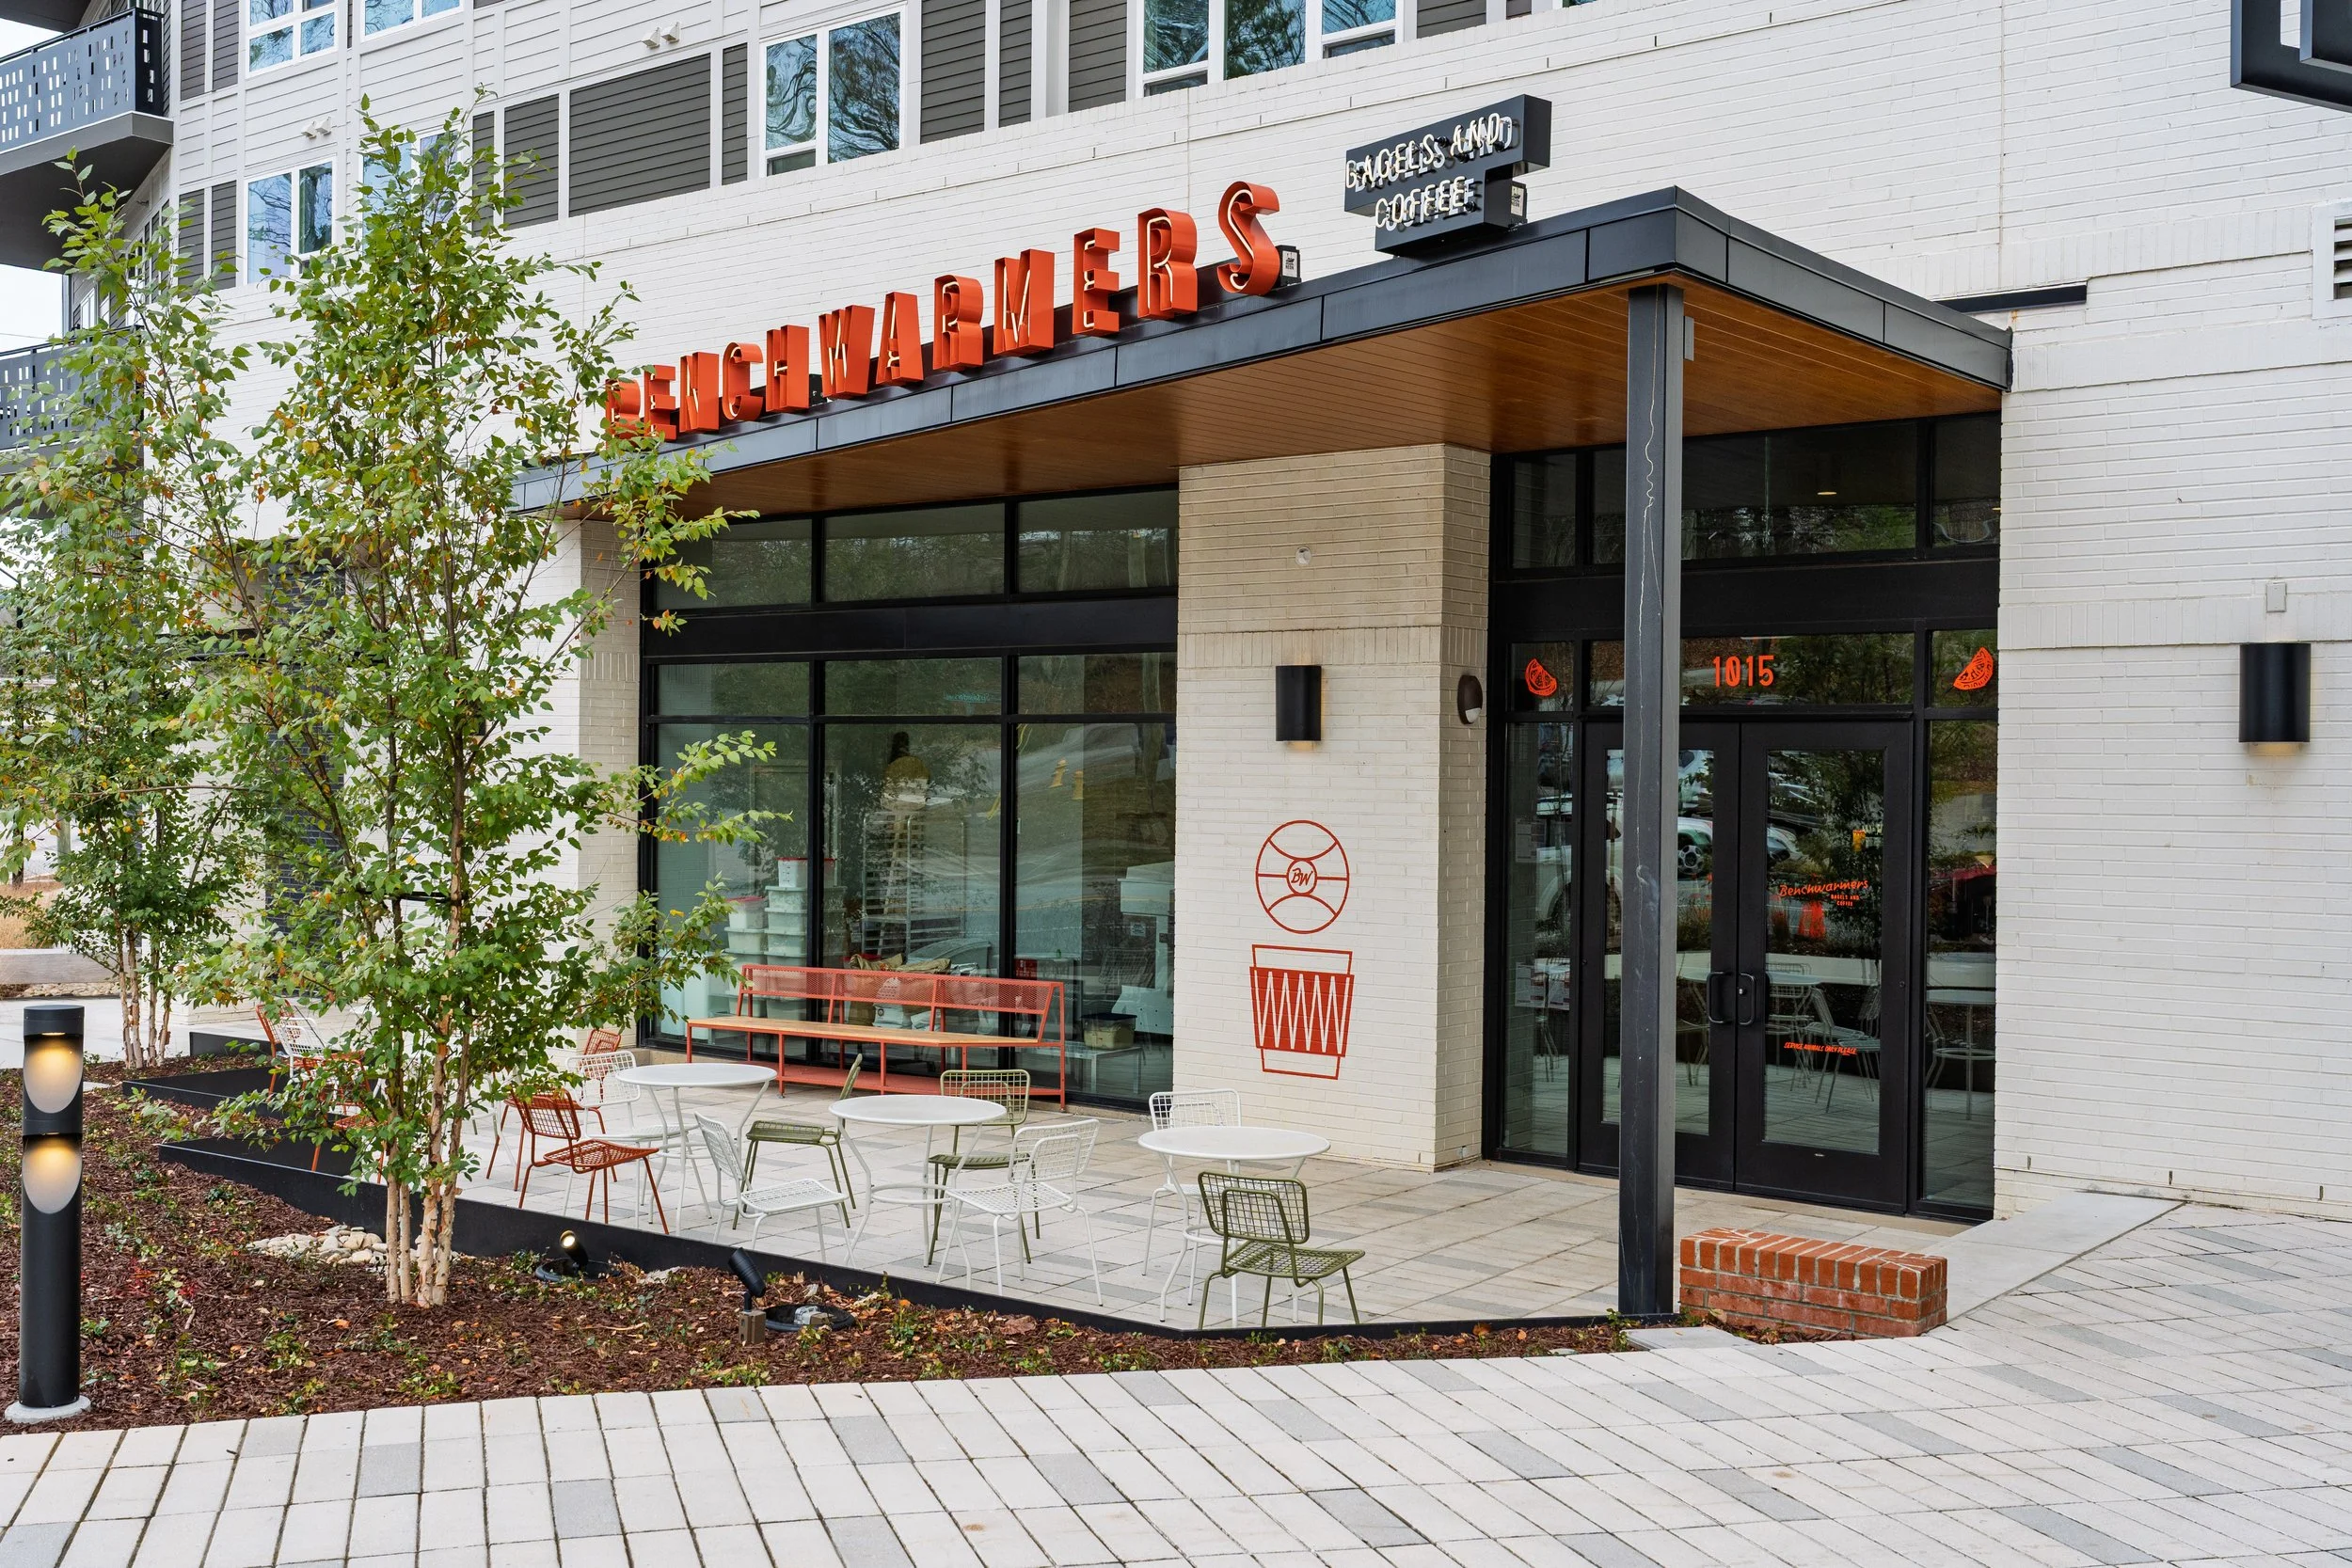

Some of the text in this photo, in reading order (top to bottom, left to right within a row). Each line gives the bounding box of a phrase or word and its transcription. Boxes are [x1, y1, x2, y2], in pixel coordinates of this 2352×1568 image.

[1345, 112, 1514, 193] BAGELS AND
[1375, 176, 1475, 231] COFFEE
[605, 181, 1280, 451] BENCHWARMERS
[1712, 655, 1774, 688] 1015
[1779, 879, 1869, 896] Benchwarmers
[1784, 1041, 1804, 1050] SERVICE
[1804, 1043, 1824, 1052] ANIMALS
[1837, 1046, 1857, 1054] PLEASE
